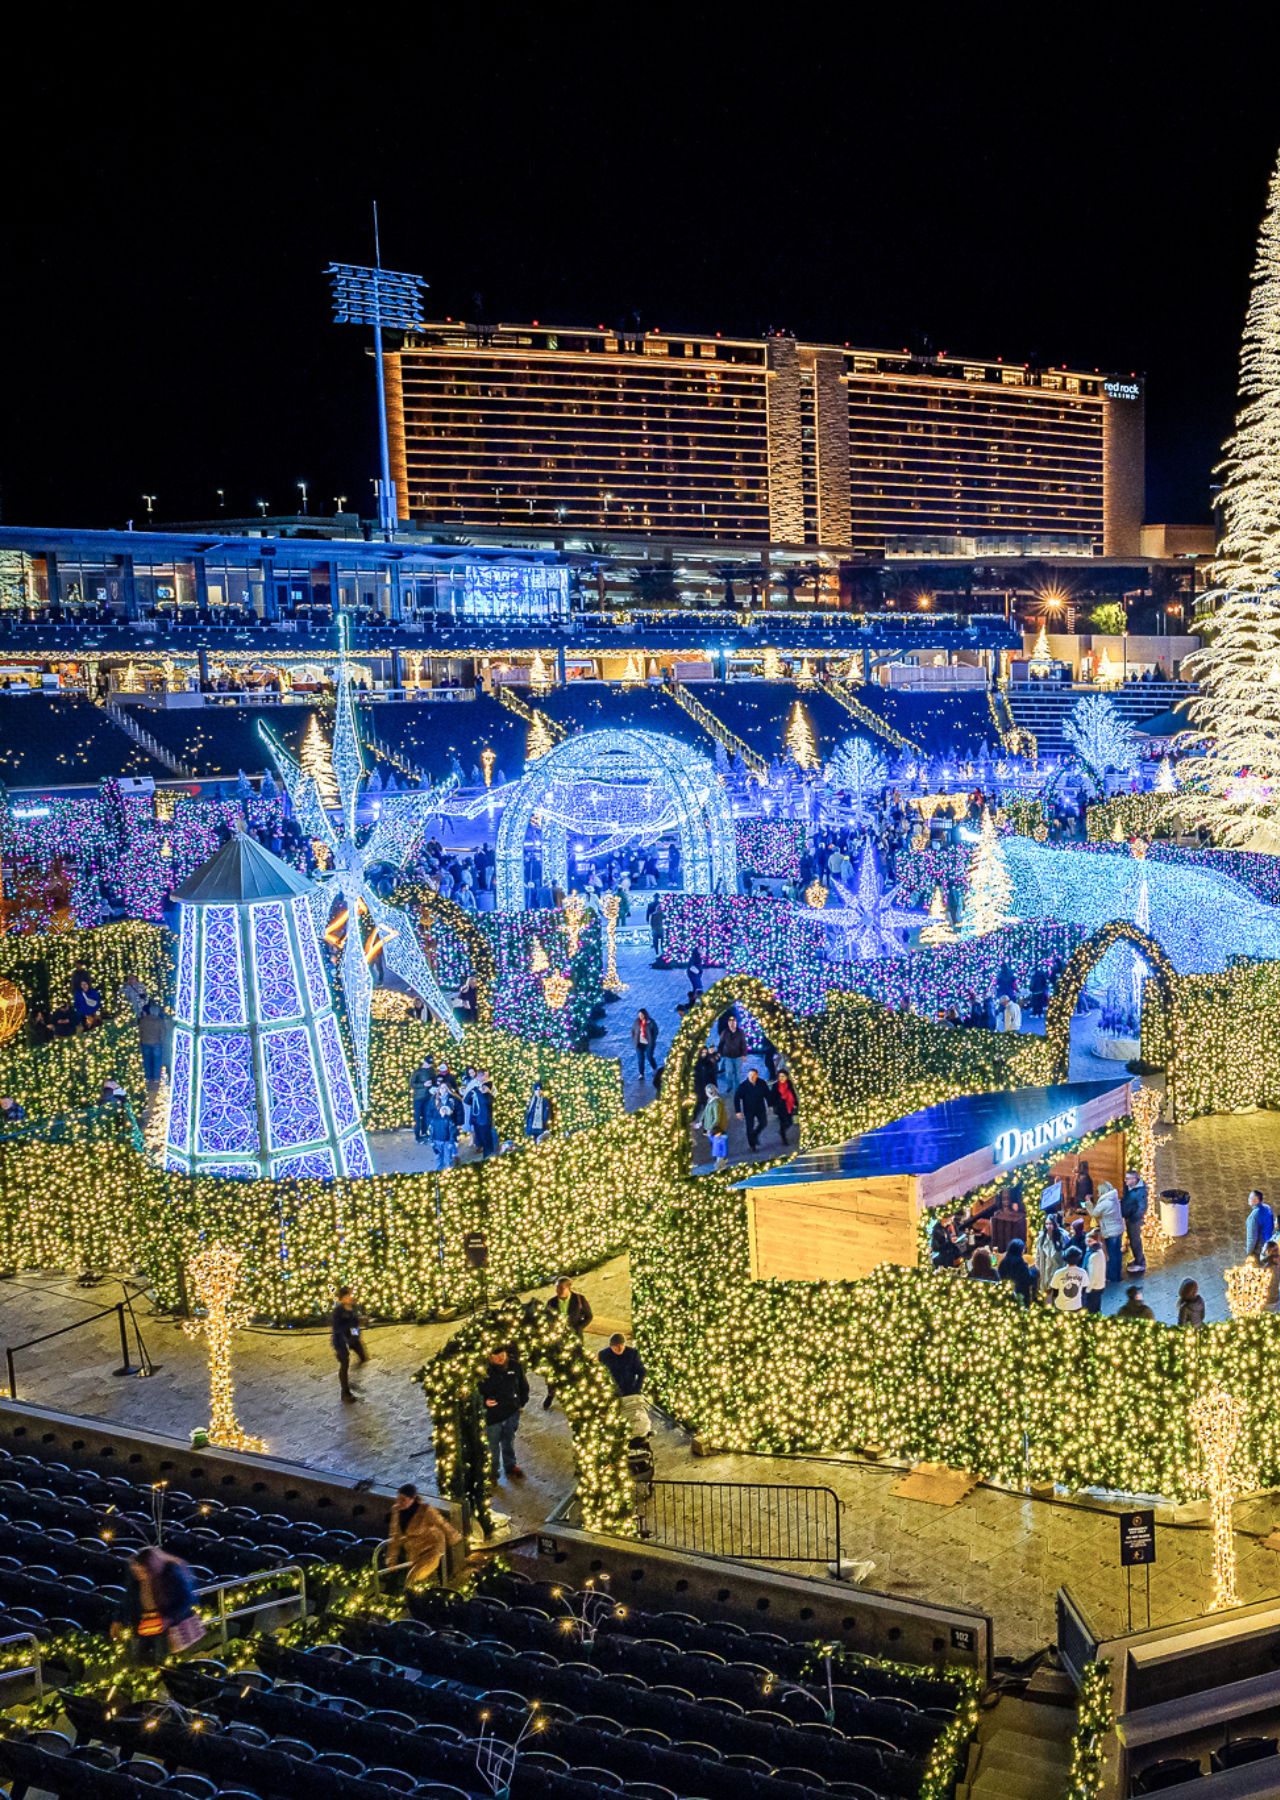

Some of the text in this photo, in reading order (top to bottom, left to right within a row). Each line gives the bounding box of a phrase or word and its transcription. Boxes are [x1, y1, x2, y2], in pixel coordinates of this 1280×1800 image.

[1104, 382, 1139, 394] red rock
[955, 1631, 969, 1642] 102
